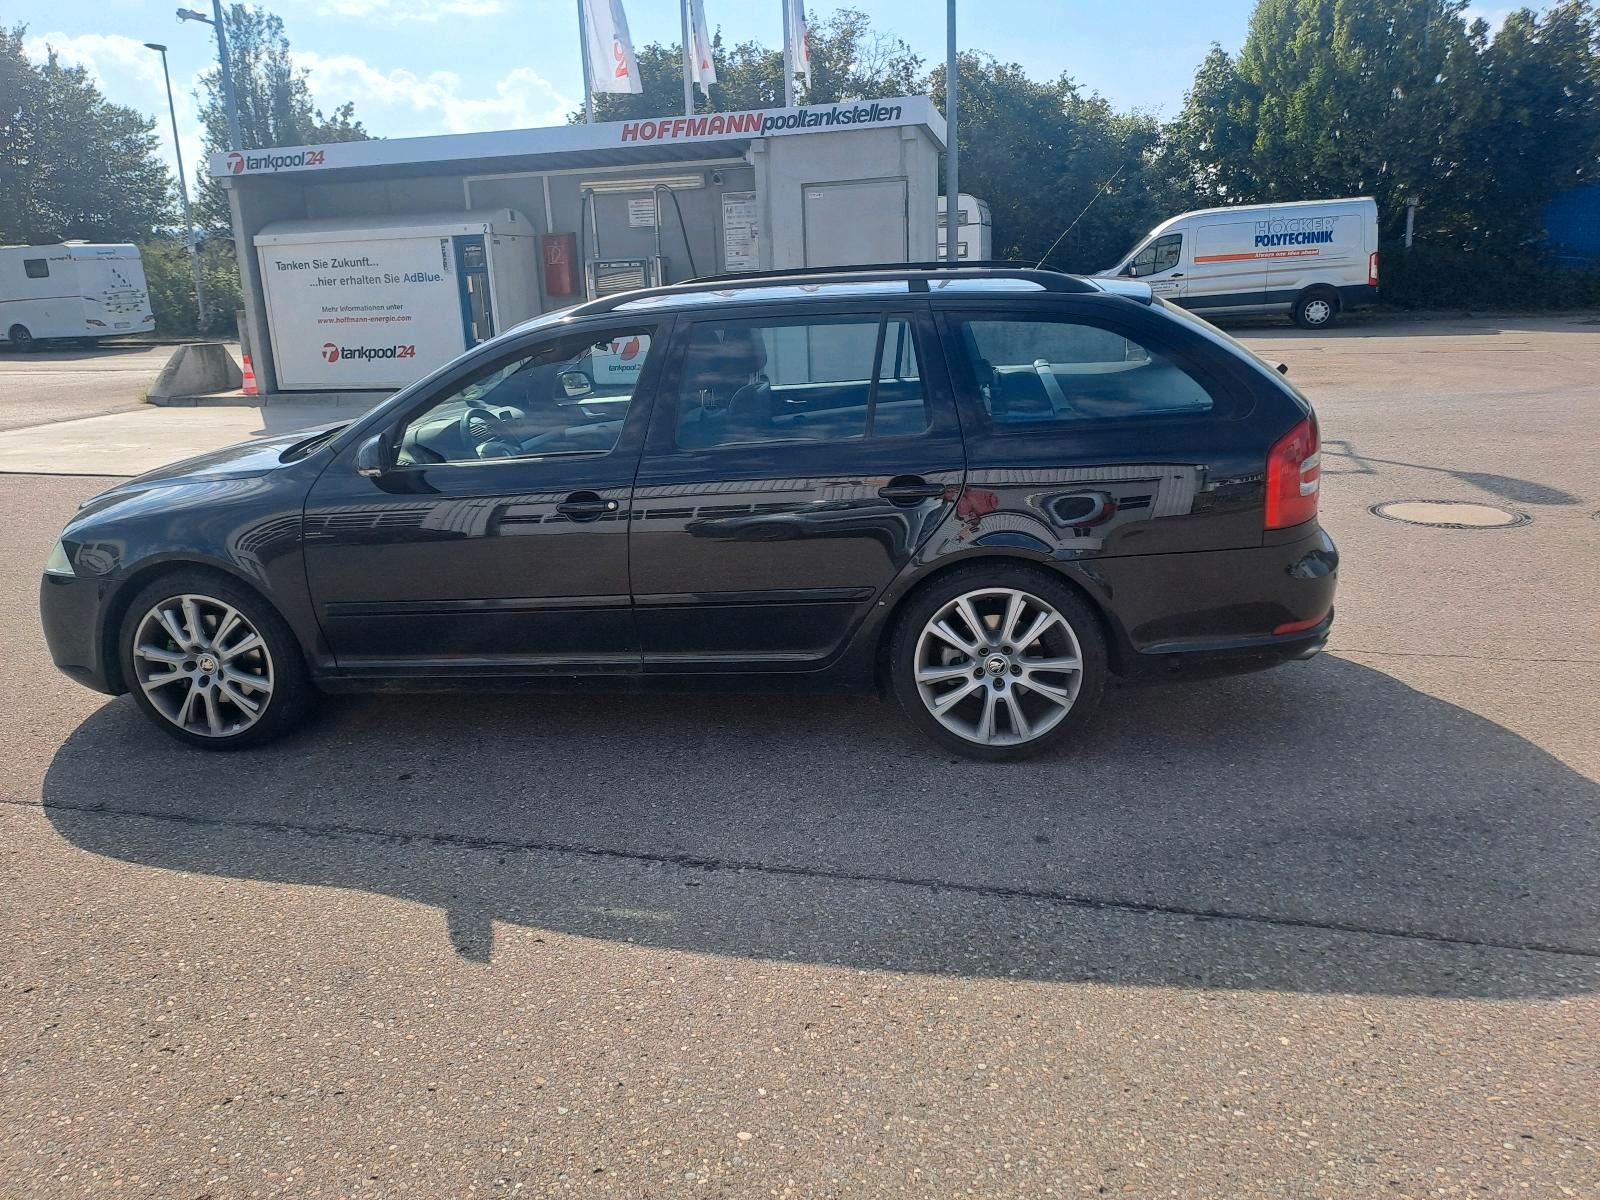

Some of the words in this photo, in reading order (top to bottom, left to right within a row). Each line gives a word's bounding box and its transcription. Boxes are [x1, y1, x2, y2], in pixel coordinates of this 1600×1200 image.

[246, 150, 325, 171] tankpool24
[1255, 216, 1335, 234] HÖCKER
[1254, 230, 1334, 247] POLYTECHNIK
[275, 260, 310, 271] Tanken
[312, 259, 328, 269] Sie
[331, 257, 379, 269] Zukunft...
[309, 276, 337, 287] ...hier
[340, 274, 382, 286] erhalten
[384, 273, 400, 284] Sie
[403, 272, 444, 283] AdBlue.
[321, 305, 338, 313] Mehr
[339, 304, 385, 313] Informationen
[386, 303, 404, 311] unter
[317, 314, 412, 325] www.hoffmann-energie.com
[341, 344, 416, 363] tankpool24
